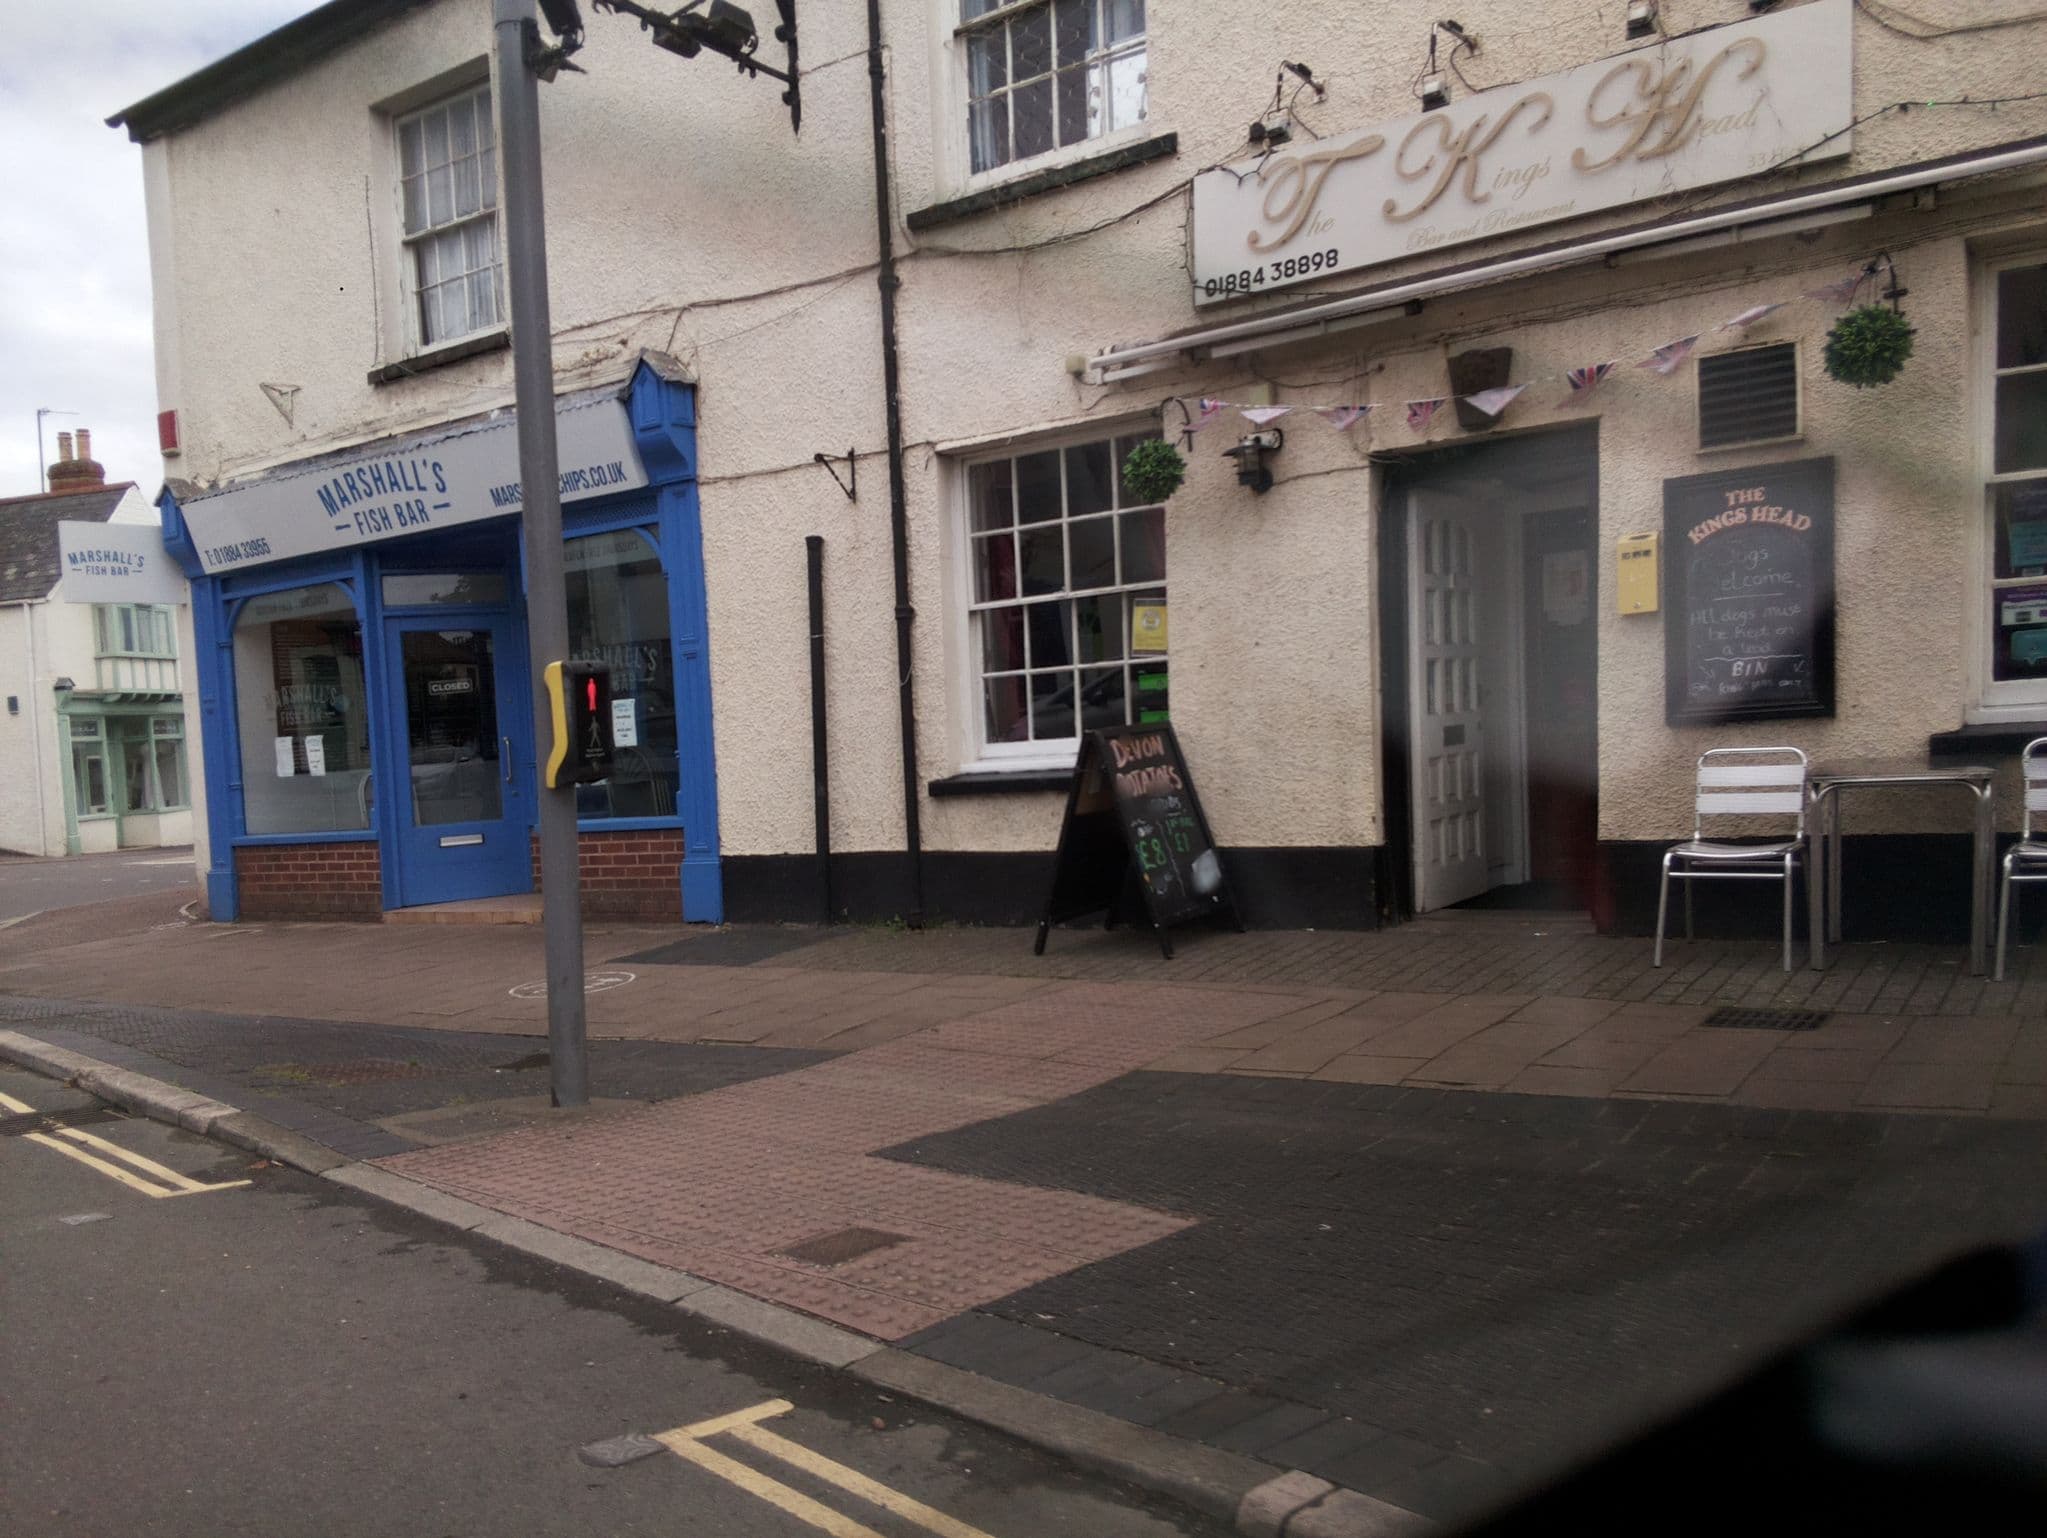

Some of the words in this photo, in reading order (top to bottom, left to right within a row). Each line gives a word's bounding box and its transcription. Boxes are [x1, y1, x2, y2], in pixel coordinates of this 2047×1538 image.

[1205, 267, 1265, 297] 01884
[1270, 248, 1339, 281] 38898
[316, 459, 448, 519] MARSHALL'S
[1725, 486, 1766, 507] THE
[354, 506, 393, 536] FISH
[400, 499, 430, 527] BAR
[1687, 506, 1747, 545] KINGS
[1751, 505, 1812, 531] HEAD
[67, 549, 145, 568] MARSHALL'S
[86, 565, 107, 576] FISH
[110, 566, 130, 577] BAR
[1731, 661, 1768, 677] BIN
[431, 682, 470, 692] CLOSED
